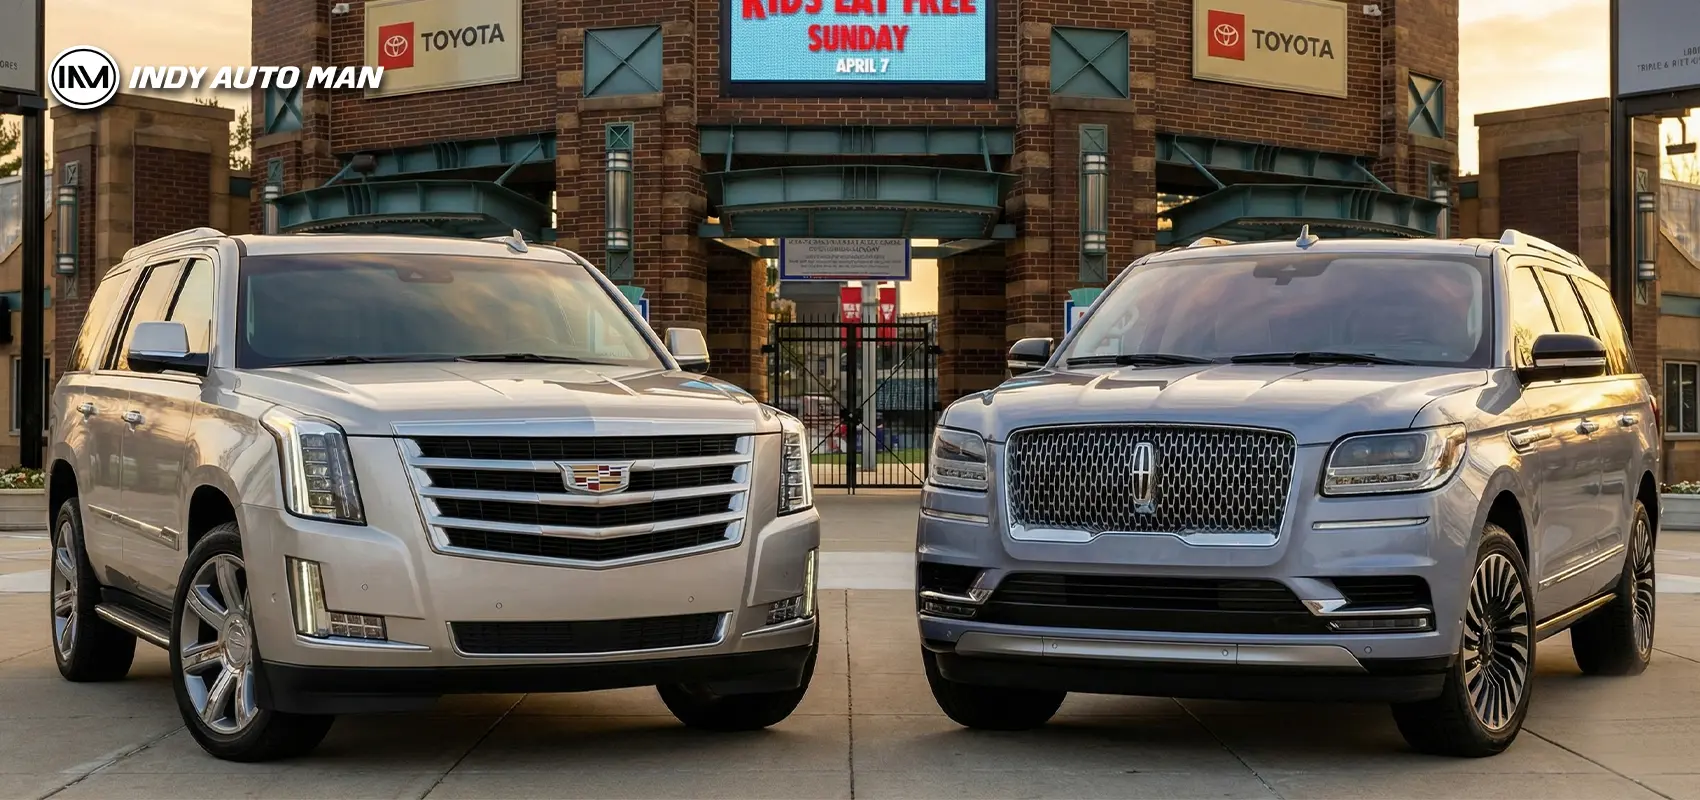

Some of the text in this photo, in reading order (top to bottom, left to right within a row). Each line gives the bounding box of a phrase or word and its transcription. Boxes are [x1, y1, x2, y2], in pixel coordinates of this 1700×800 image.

[421, 23, 505, 51] TOYOTA
[807, 24, 909, 52] SUNDAY
[1252, 29, 1335, 59] TOYOTA
[835, 58, 890, 73] APRIL 7
